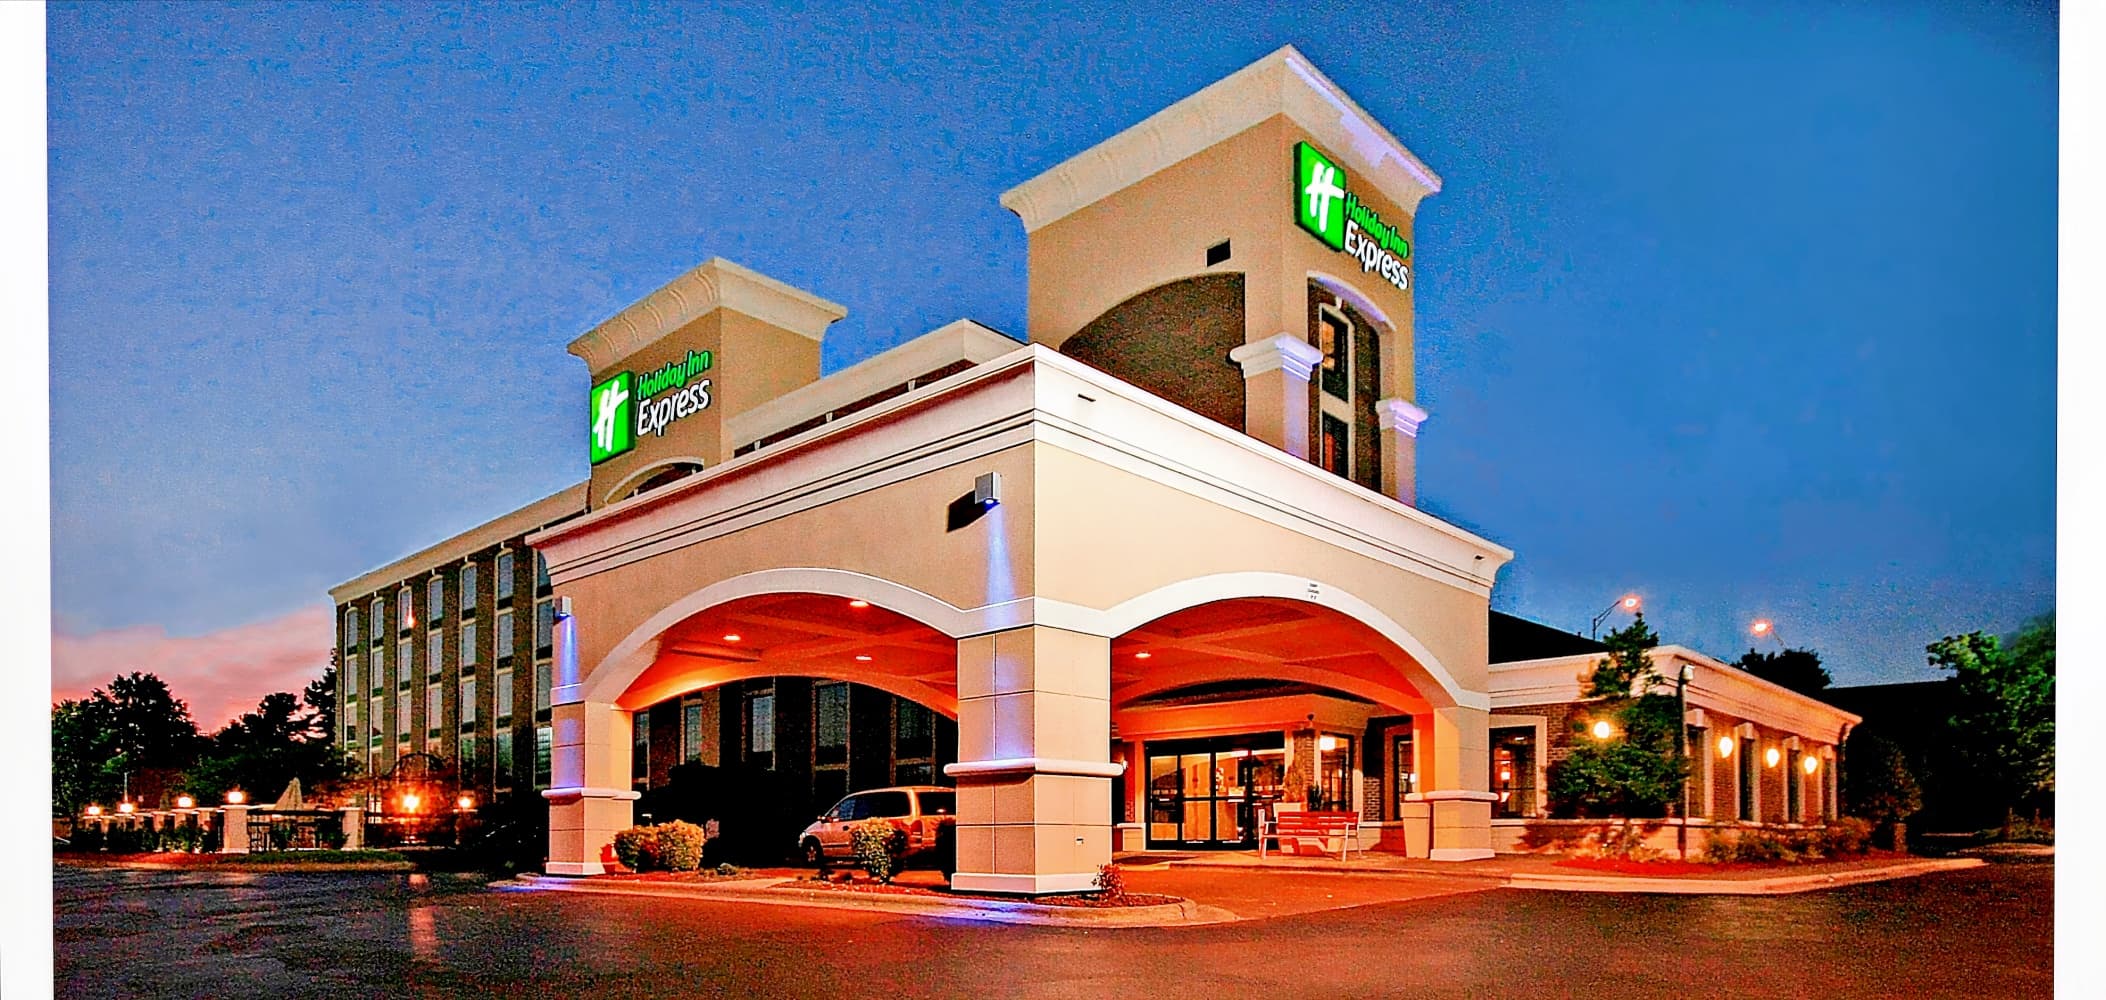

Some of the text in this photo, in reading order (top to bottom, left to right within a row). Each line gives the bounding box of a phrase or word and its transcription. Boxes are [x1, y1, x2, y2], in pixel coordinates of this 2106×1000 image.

[1344, 219, 1409, 290] Express
[1346, 192, 1409, 259] Holiday Inn
[637, 350, 711, 401] Holiday Inn
[636, 379, 711, 437] Express
